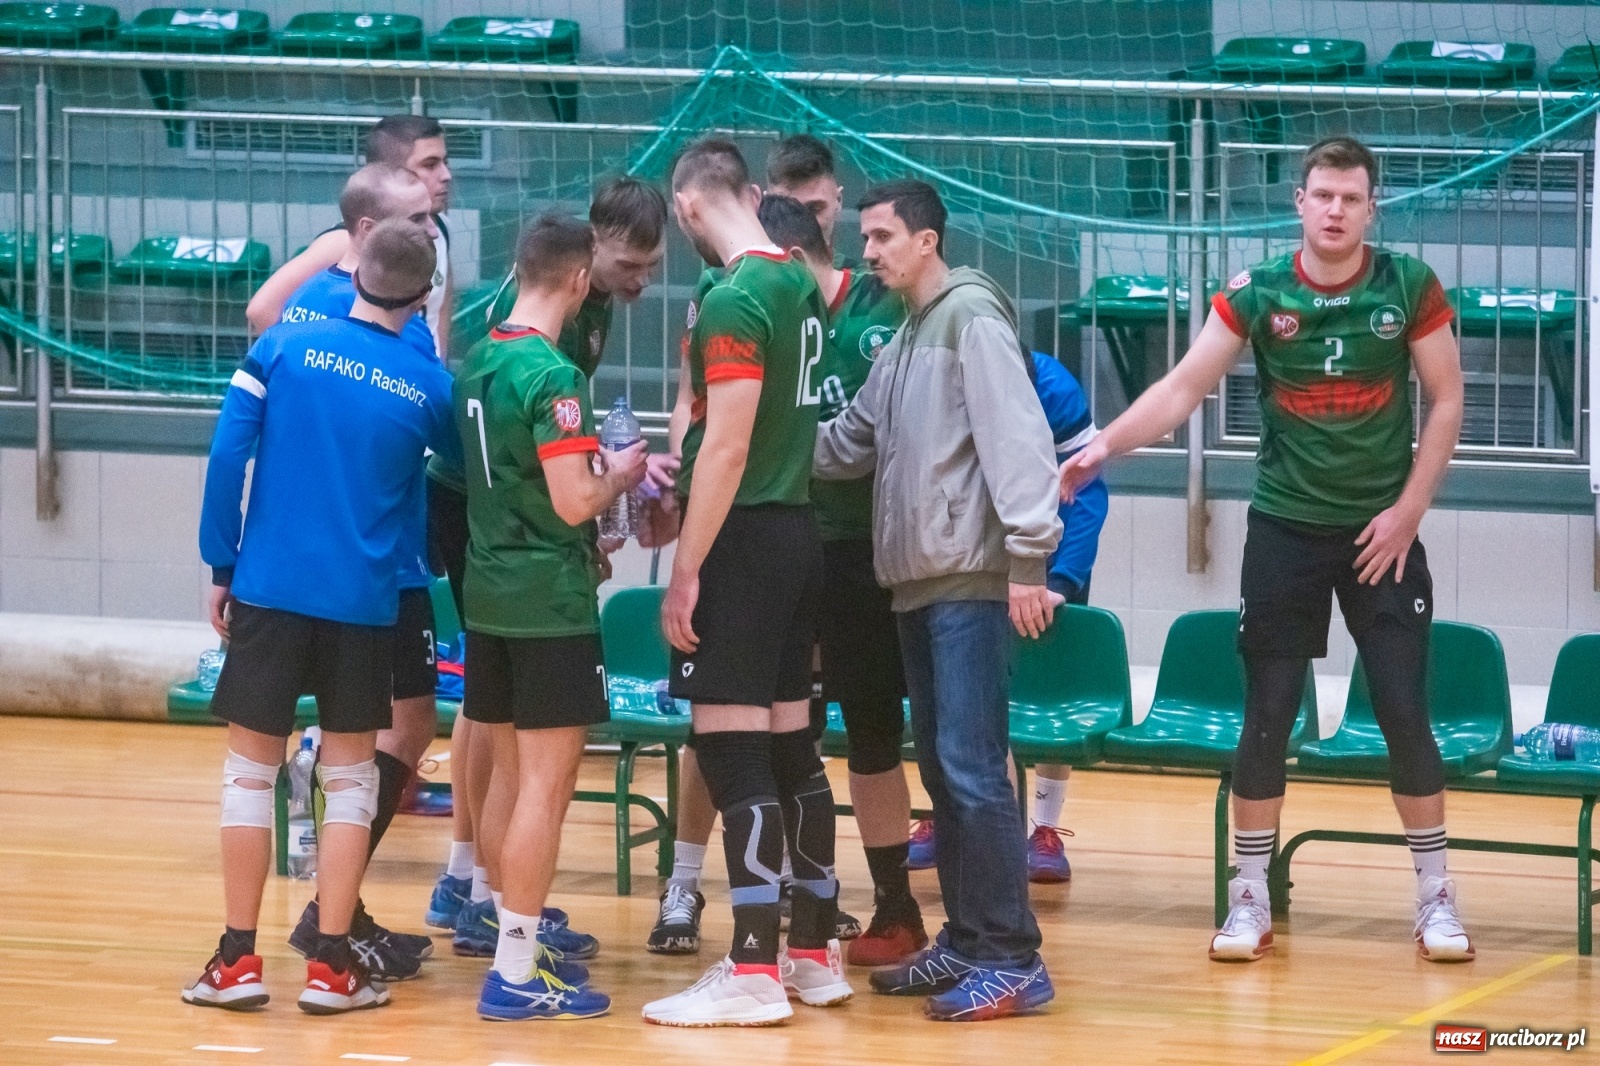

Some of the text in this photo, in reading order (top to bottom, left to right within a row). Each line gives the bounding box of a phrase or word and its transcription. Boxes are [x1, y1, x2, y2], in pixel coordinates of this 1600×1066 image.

[1324, 296, 1351, 307] VIGO
[796, 316, 823, 407] 12
[1324, 337, 1343, 376] 2
[304, 348, 427, 408] RAFAKO Racibórz
[467, 398, 492, 489] 7
[422, 629, 435, 665] 3
[596, 664, 608, 701] 7
